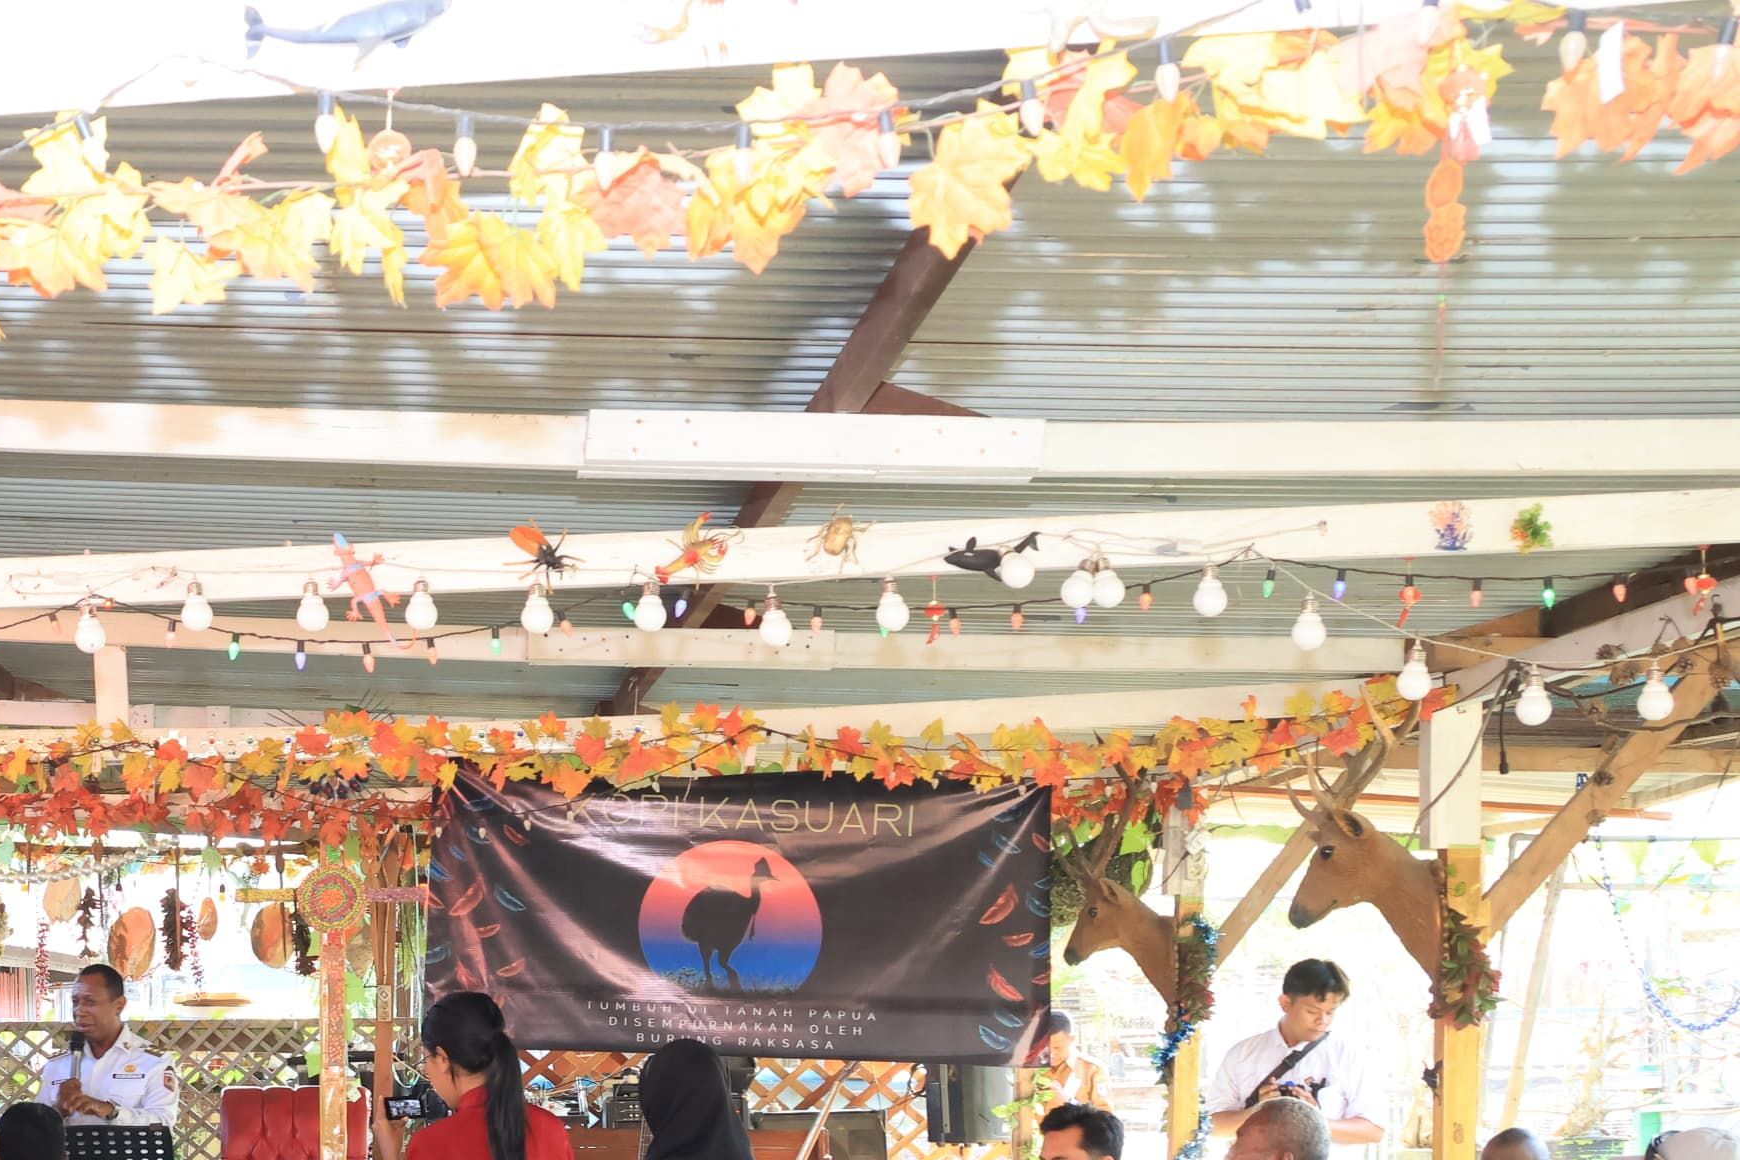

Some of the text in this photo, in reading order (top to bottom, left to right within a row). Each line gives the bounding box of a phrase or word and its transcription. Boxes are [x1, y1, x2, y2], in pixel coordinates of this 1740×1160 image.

[570, 792, 915, 837] KOPI KASUARI
[587, 1000, 673, 1014] TUMBUH
[724, 1006, 793, 1017] TANAH
[809, 1009, 877, 1021] PAPUA
[608, 1015, 863, 1036] DISEMPURNAKAN OLEH
[738, 1036, 834, 1050] RAKSASA
